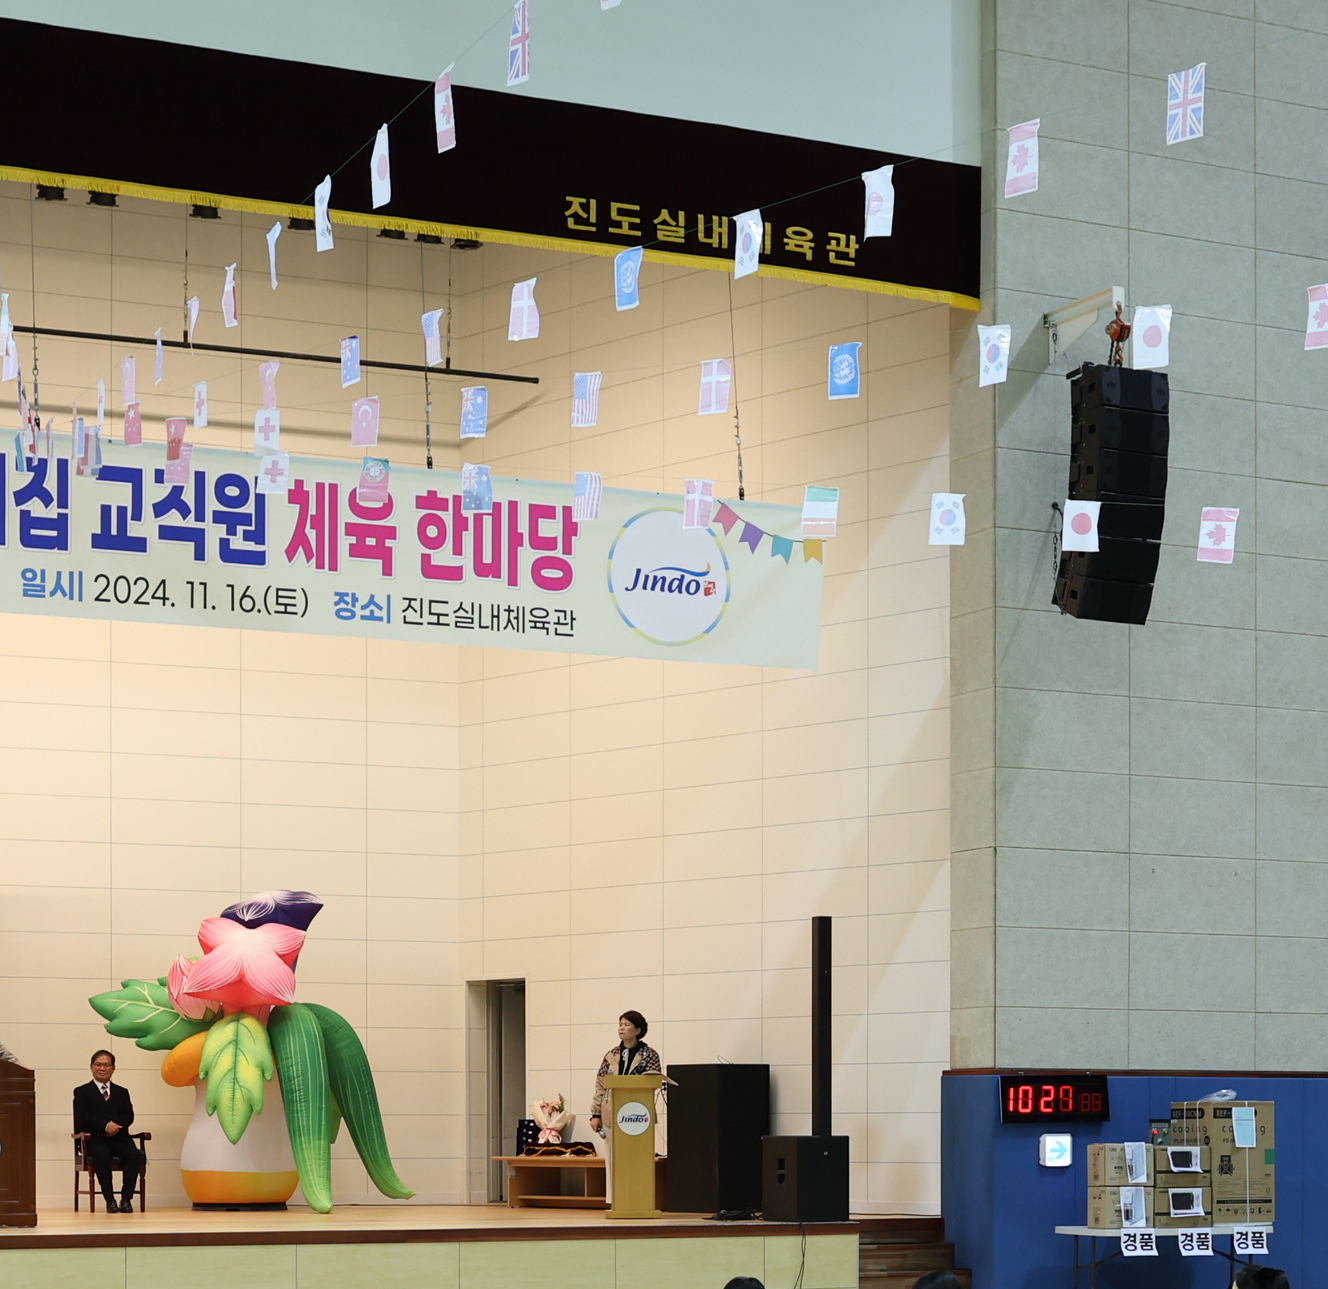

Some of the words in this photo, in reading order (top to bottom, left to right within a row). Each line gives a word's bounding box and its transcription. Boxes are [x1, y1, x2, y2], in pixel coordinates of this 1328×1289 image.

[90, 464, 268, 567] 교직원
[284, 478, 398, 578] 체육
[415, 489, 580, 592] 한마당
[624, 567, 701, 596] Jindo
[401, 596, 577, 638] 진도실내체육관
[618, 1115, 644, 1124] Jindo
[1123, 1233, 1154, 1252] 경품
[1180, 1233, 1211, 1252] 경품
[1236, 1231, 1265, 1250] 경품
